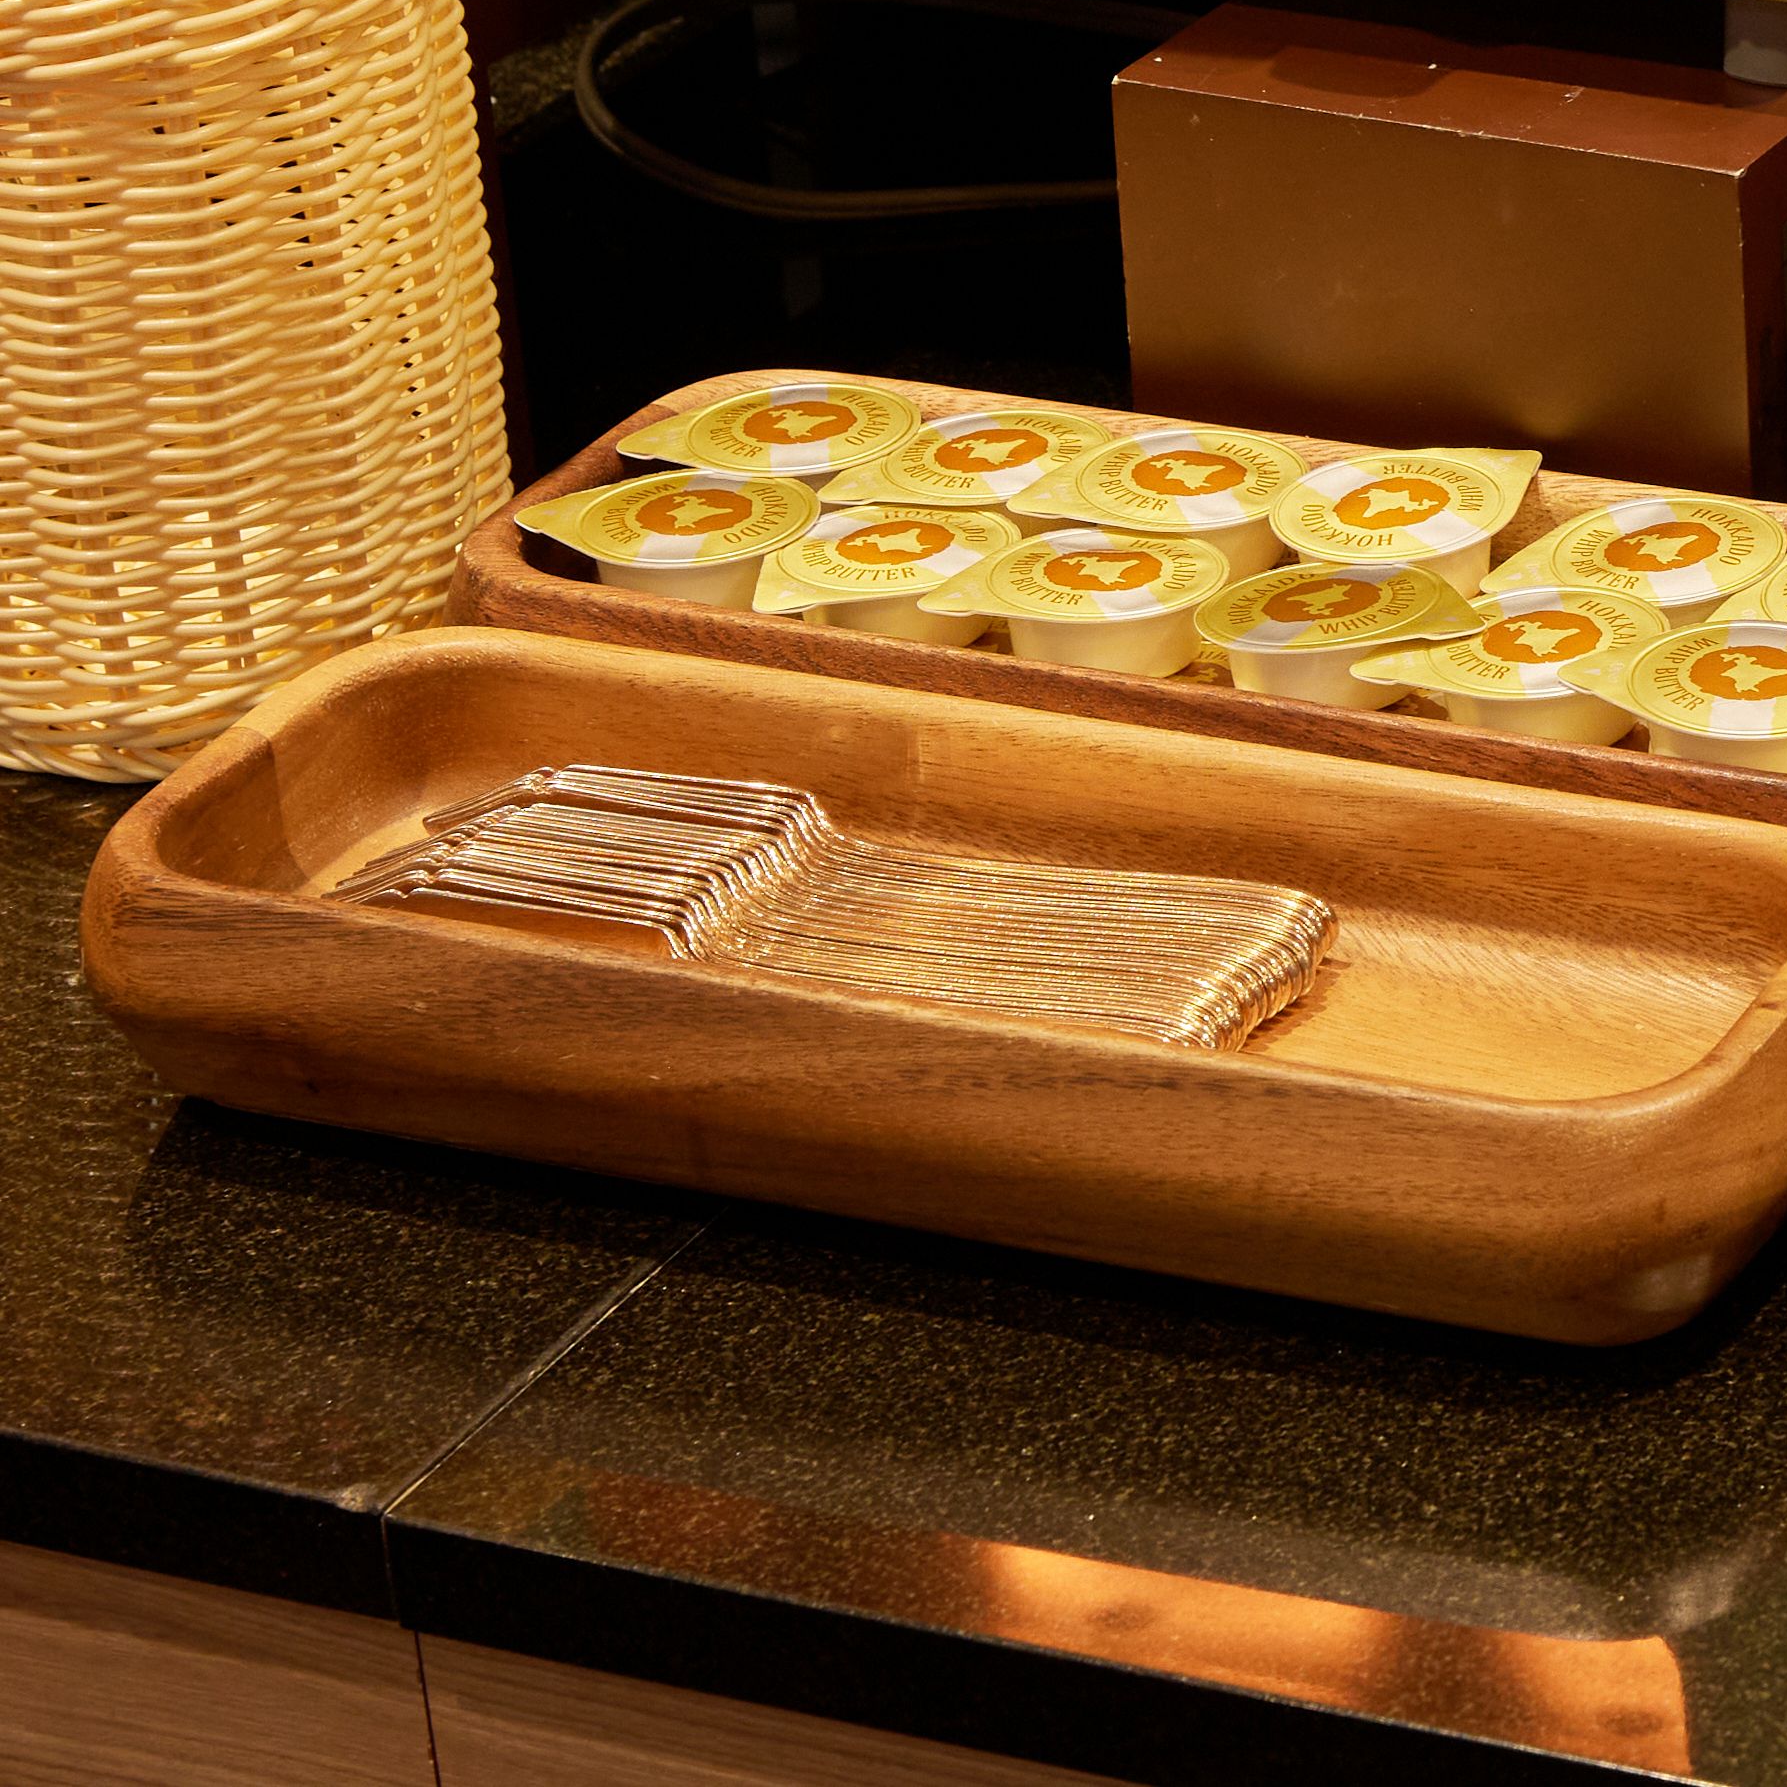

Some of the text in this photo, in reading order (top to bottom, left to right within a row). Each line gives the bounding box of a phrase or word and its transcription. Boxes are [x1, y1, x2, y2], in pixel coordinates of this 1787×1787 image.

[709, 427, 764, 459] BUTTER
[840, 393, 891, 446] HOKKAIDO
[1014, 416, 1082, 463] HOKKAIDO
[901, 438, 975, 490] WHIP BUTTER
[1099, 451, 1169, 512] WHIP BUTTER
[1215, 441, 1281, 497] HOKKAIDO
[1383, 463, 1484, 512] WHIP BUTTER
[601, 482, 676, 545] WHIP BUTTER
[723, 486, 788, 545] HOKKAIDO
[881, 508, 989, 543] HOKKAIDO
[1301, 503, 1394, 548] HOKKAIDO
[1690, 508, 1755, 566] HOKKAIDO
[800, 540, 917, 583] WHIP BUTTER
[1008, 551, 1083, 607] WHIP BUTTER
[1130, 538, 1198, 592] HOKKAIDO
[1571, 528, 1640, 590] WHIP BUTTER
[1228, 571, 1318, 625] HOKKAIDO
[1319, 578, 1417, 636] WHIP BUTTER
[1578, 600, 1639, 650] HOKKAI
[1447, 643, 1512, 680] BUTTER
[1655, 637, 1719, 711] WHIP BUTTER
